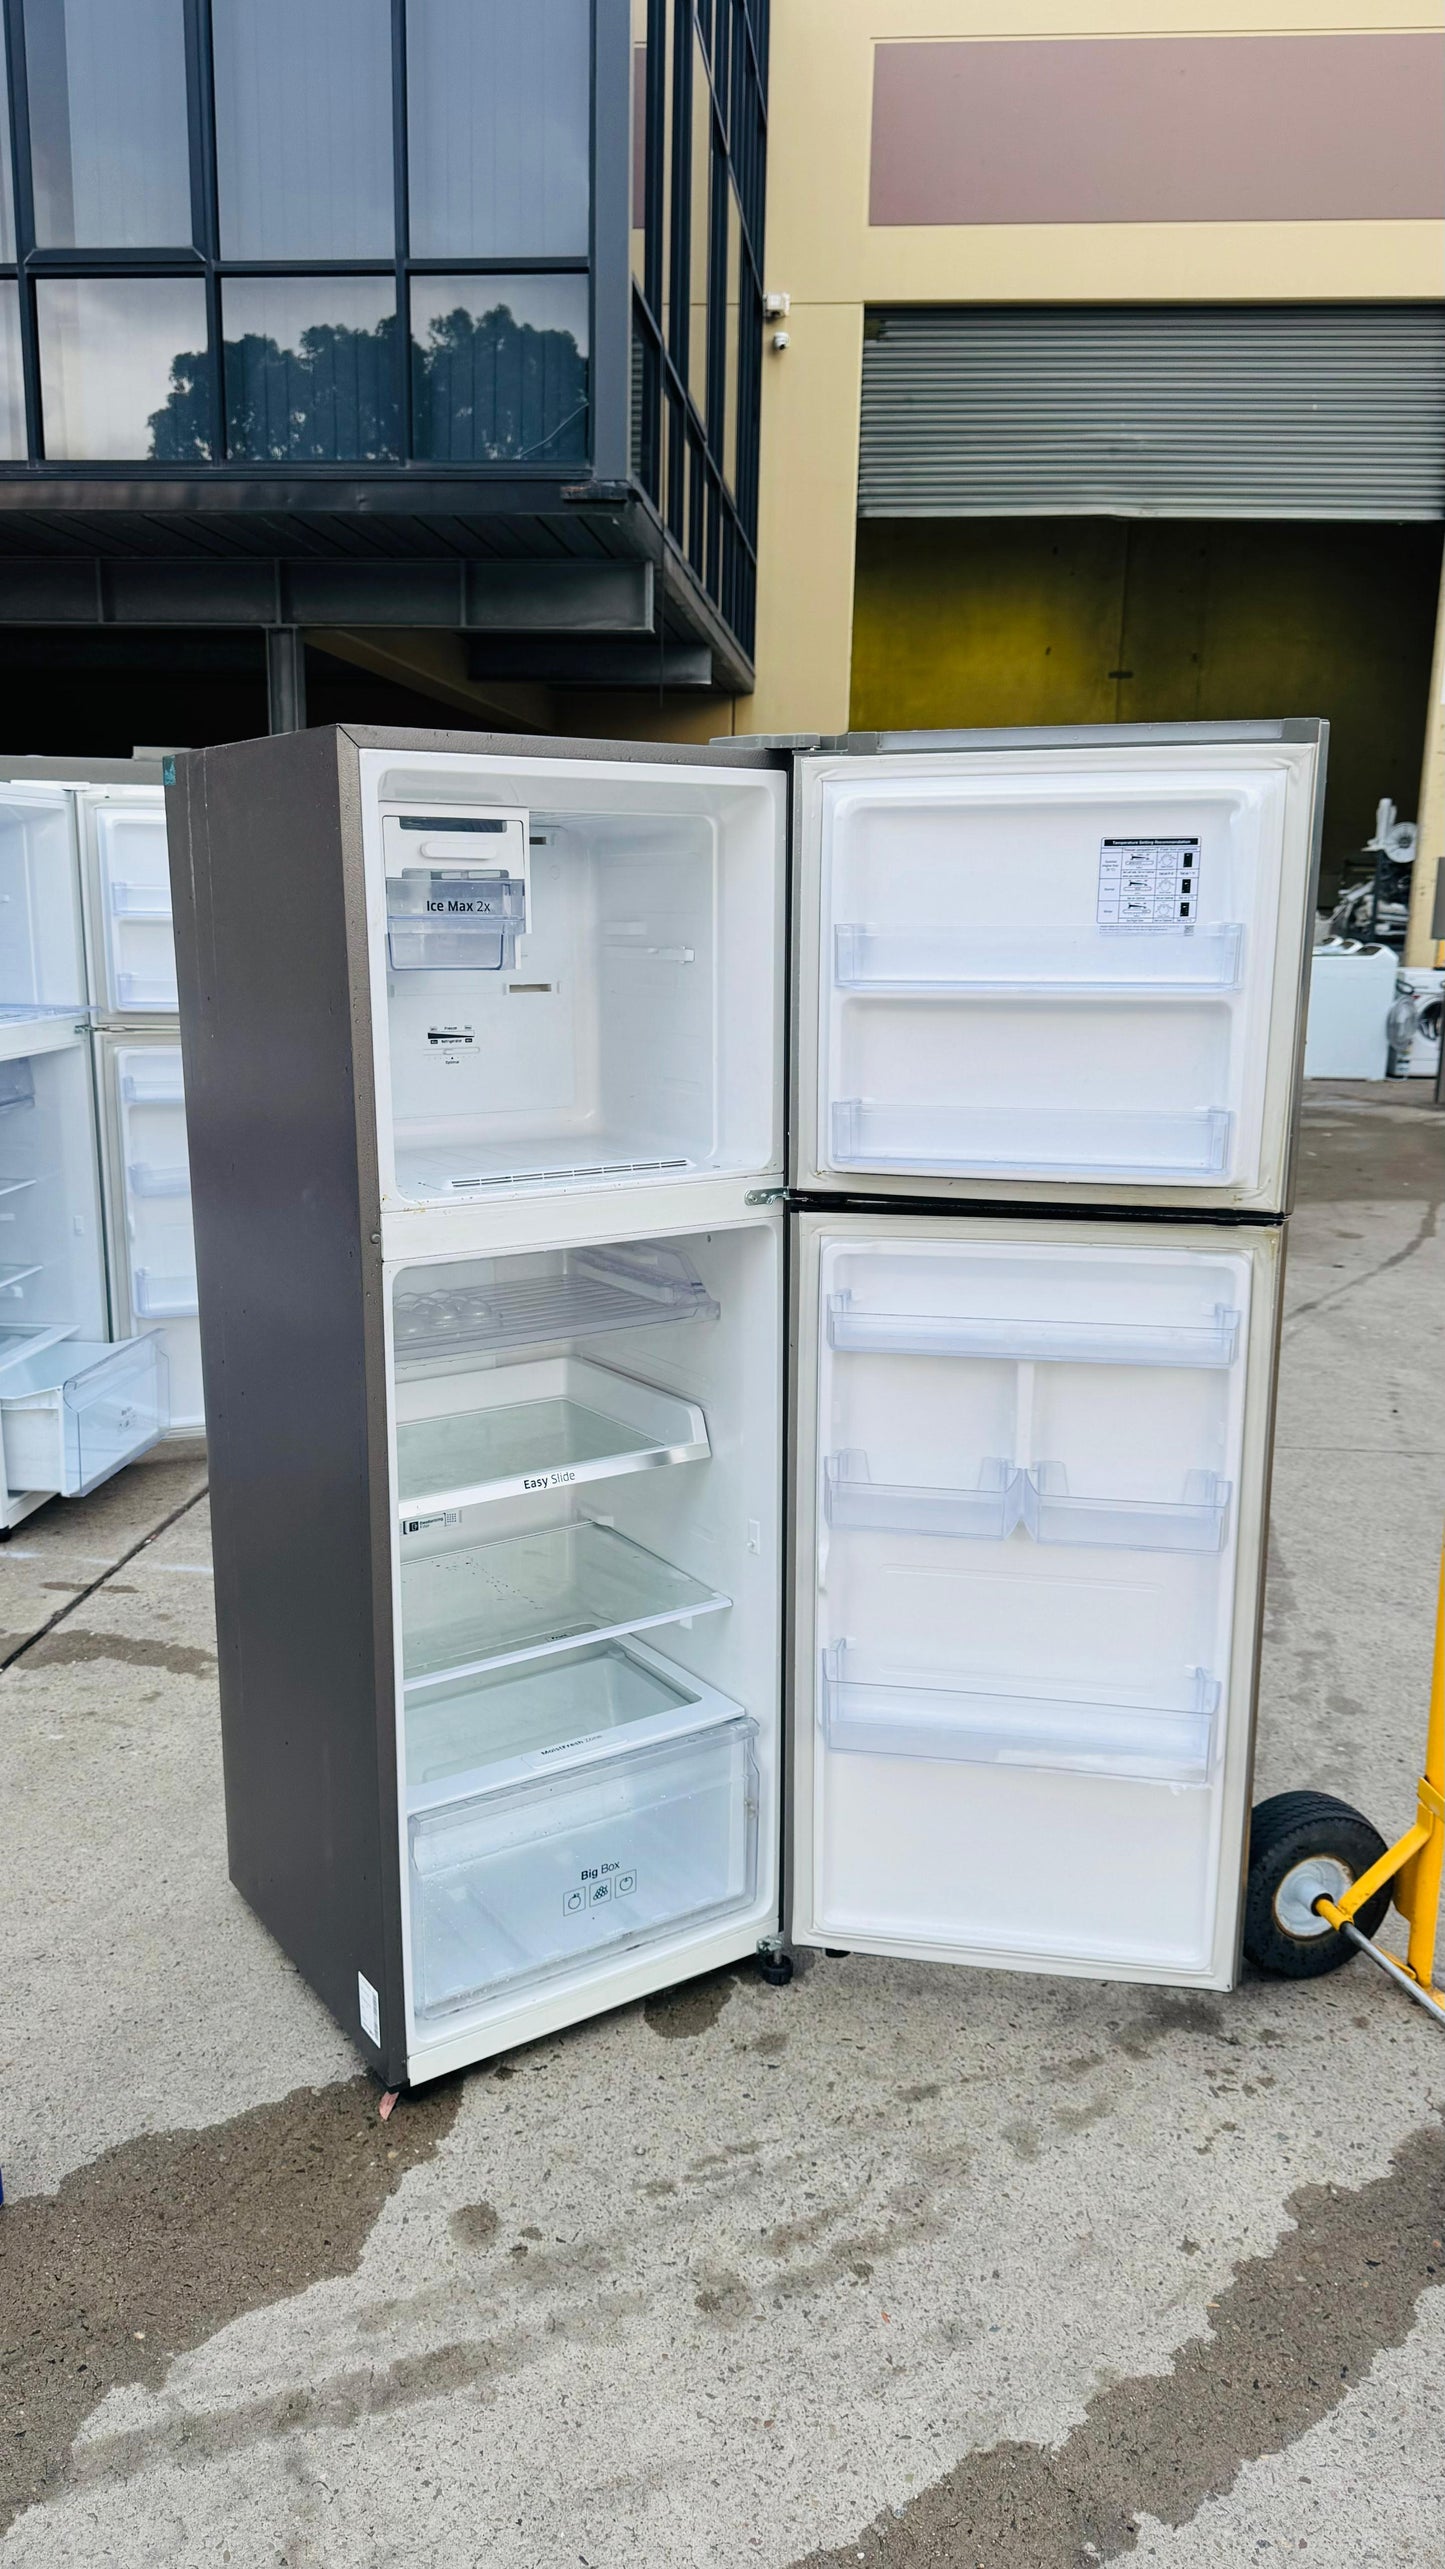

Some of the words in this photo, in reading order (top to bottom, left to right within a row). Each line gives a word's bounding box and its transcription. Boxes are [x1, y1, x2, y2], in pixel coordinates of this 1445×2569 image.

[426, 900, 444, 912] Ice
[448, 900, 474, 912] Max
[476, 900, 491, 912] 2x
[523, 1477, 548, 1490] Easy
[550, 1472, 576, 1485] Slide
[581, 1868, 598, 1881] Big
[601, 1861, 621, 1874] Box
